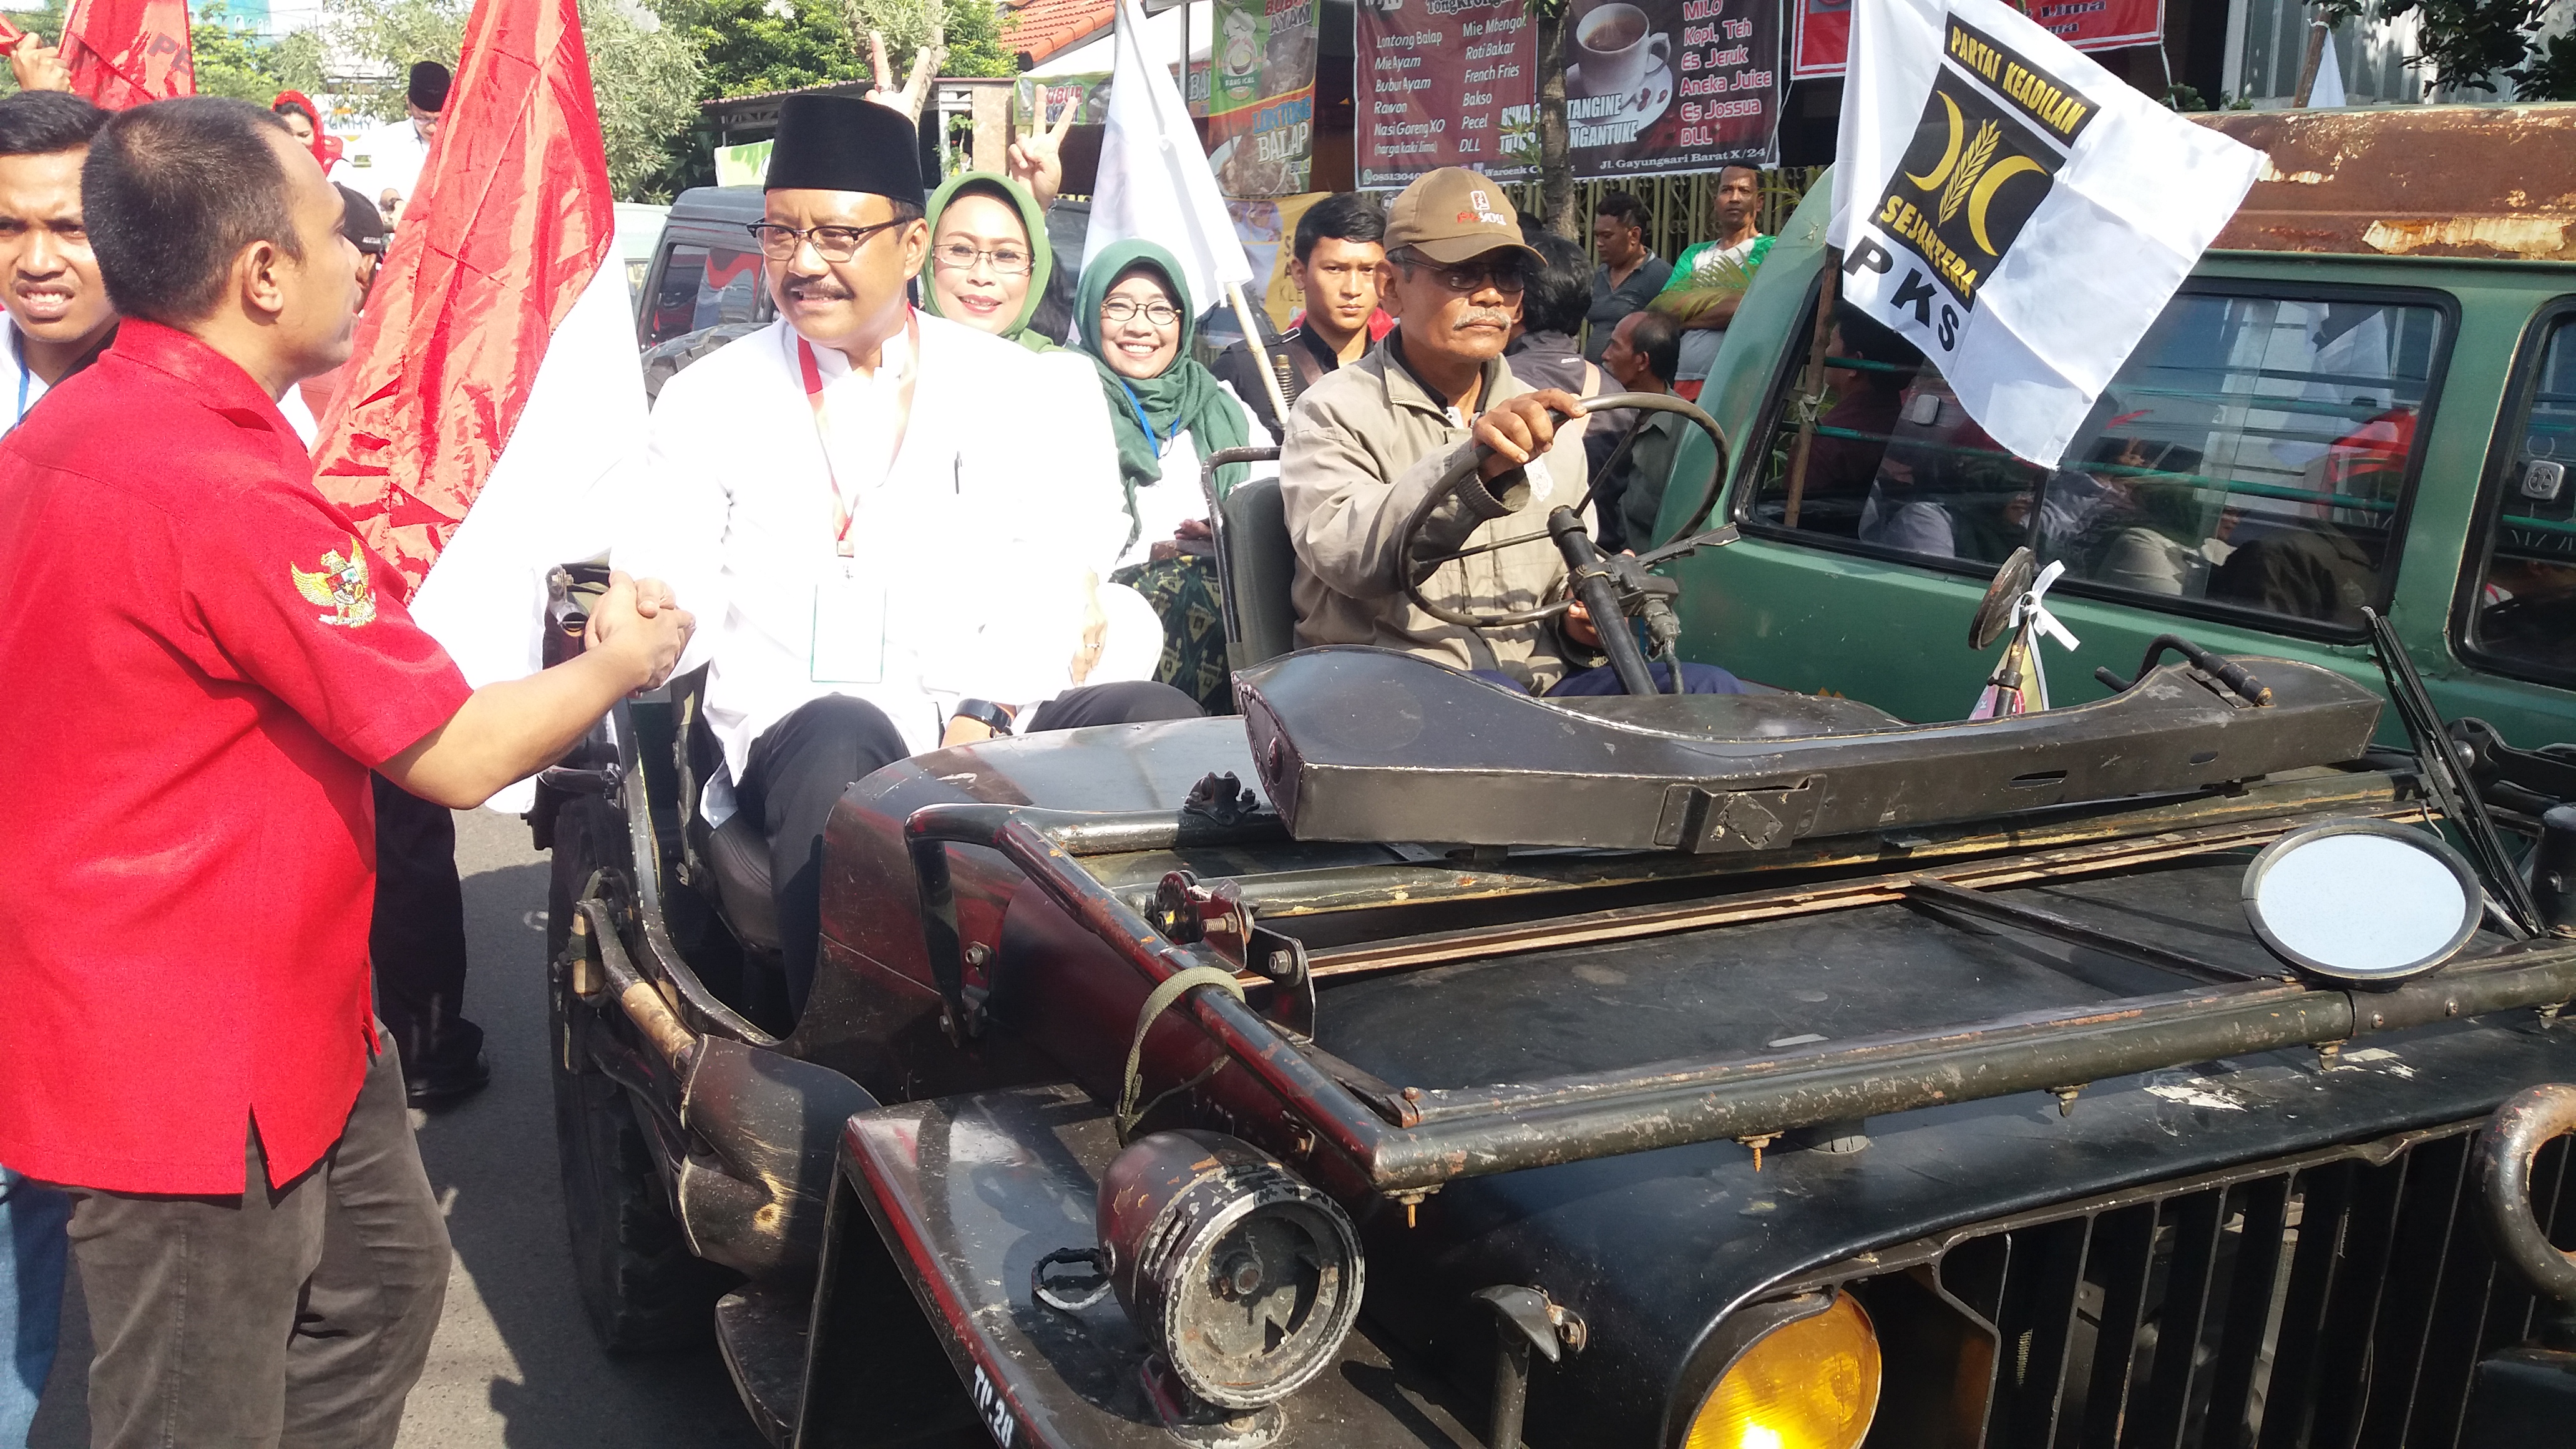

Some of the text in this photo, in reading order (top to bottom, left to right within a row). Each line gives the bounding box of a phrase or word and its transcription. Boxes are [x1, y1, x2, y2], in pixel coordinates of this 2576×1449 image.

[1269, 5, 1312, 36] AYAM
[1683, 0, 1724, 21] MILO
[1376, 29, 1443, 50] Lontong Balap
[1463, 21, 1483, 37] Mie
[1684, 17, 1752, 46] Kopi, Teh
[1465, 40, 1515, 60] Roti Bakar
[1681, 44, 1749, 71] Es Jeruk
[1375, 55, 1422, 72] Mie Ayam
[1464, 62, 1520, 83] French Fries
[1375, 77, 1432, 94] Bubur Ayam
[1679, 69, 1772, 97] Aneka Juice
[1951, 26, 2087, 135] PARTAI KEADILAN
[1046, 85, 1084, 105] UBUR
[1462, 90, 1492, 107] Bakso
[1252, 94, 1312, 137] LONTONG
[1374, 101, 1407, 114] Rawon
[1681, 99, 1762, 121] Es Jossua
[1374, 119, 1445, 138] Nasi Goreng XO
[1461, 113, 1489, 130] Pecel
[1257, 121, 1309, 165] BALAP
[1459, 138, 1480, 152] DLL
[1681, 126, 1713, 147] DLL
[1599, 148, 1767, 170] Jl. Gayungsari Barat X/24
[1373, 172, 1424, 181] 08513040
[1843, 235, 1959, 351] PKS
